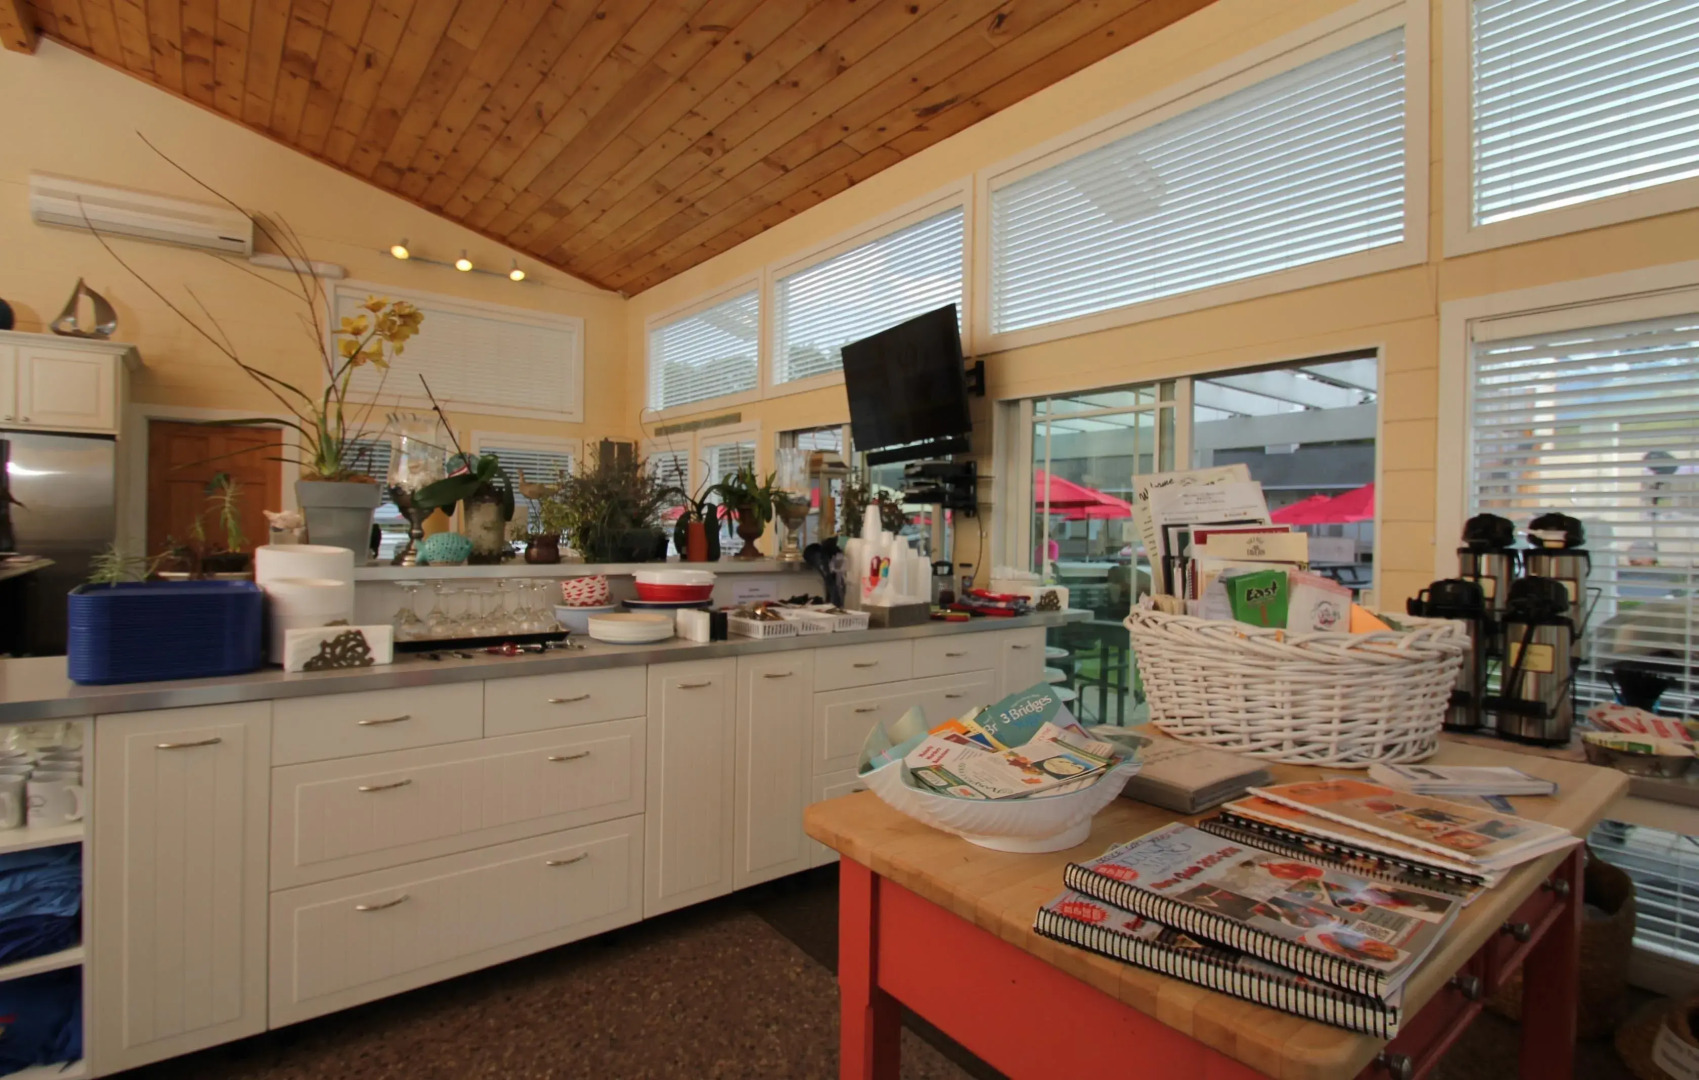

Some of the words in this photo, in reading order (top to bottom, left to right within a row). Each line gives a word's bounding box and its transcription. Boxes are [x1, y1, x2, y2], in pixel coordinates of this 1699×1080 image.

[1246, 579, 1277, 602] East
[1000, 712, 1010, 724] 3
[1009, 695, 1052, 720] Bridges
